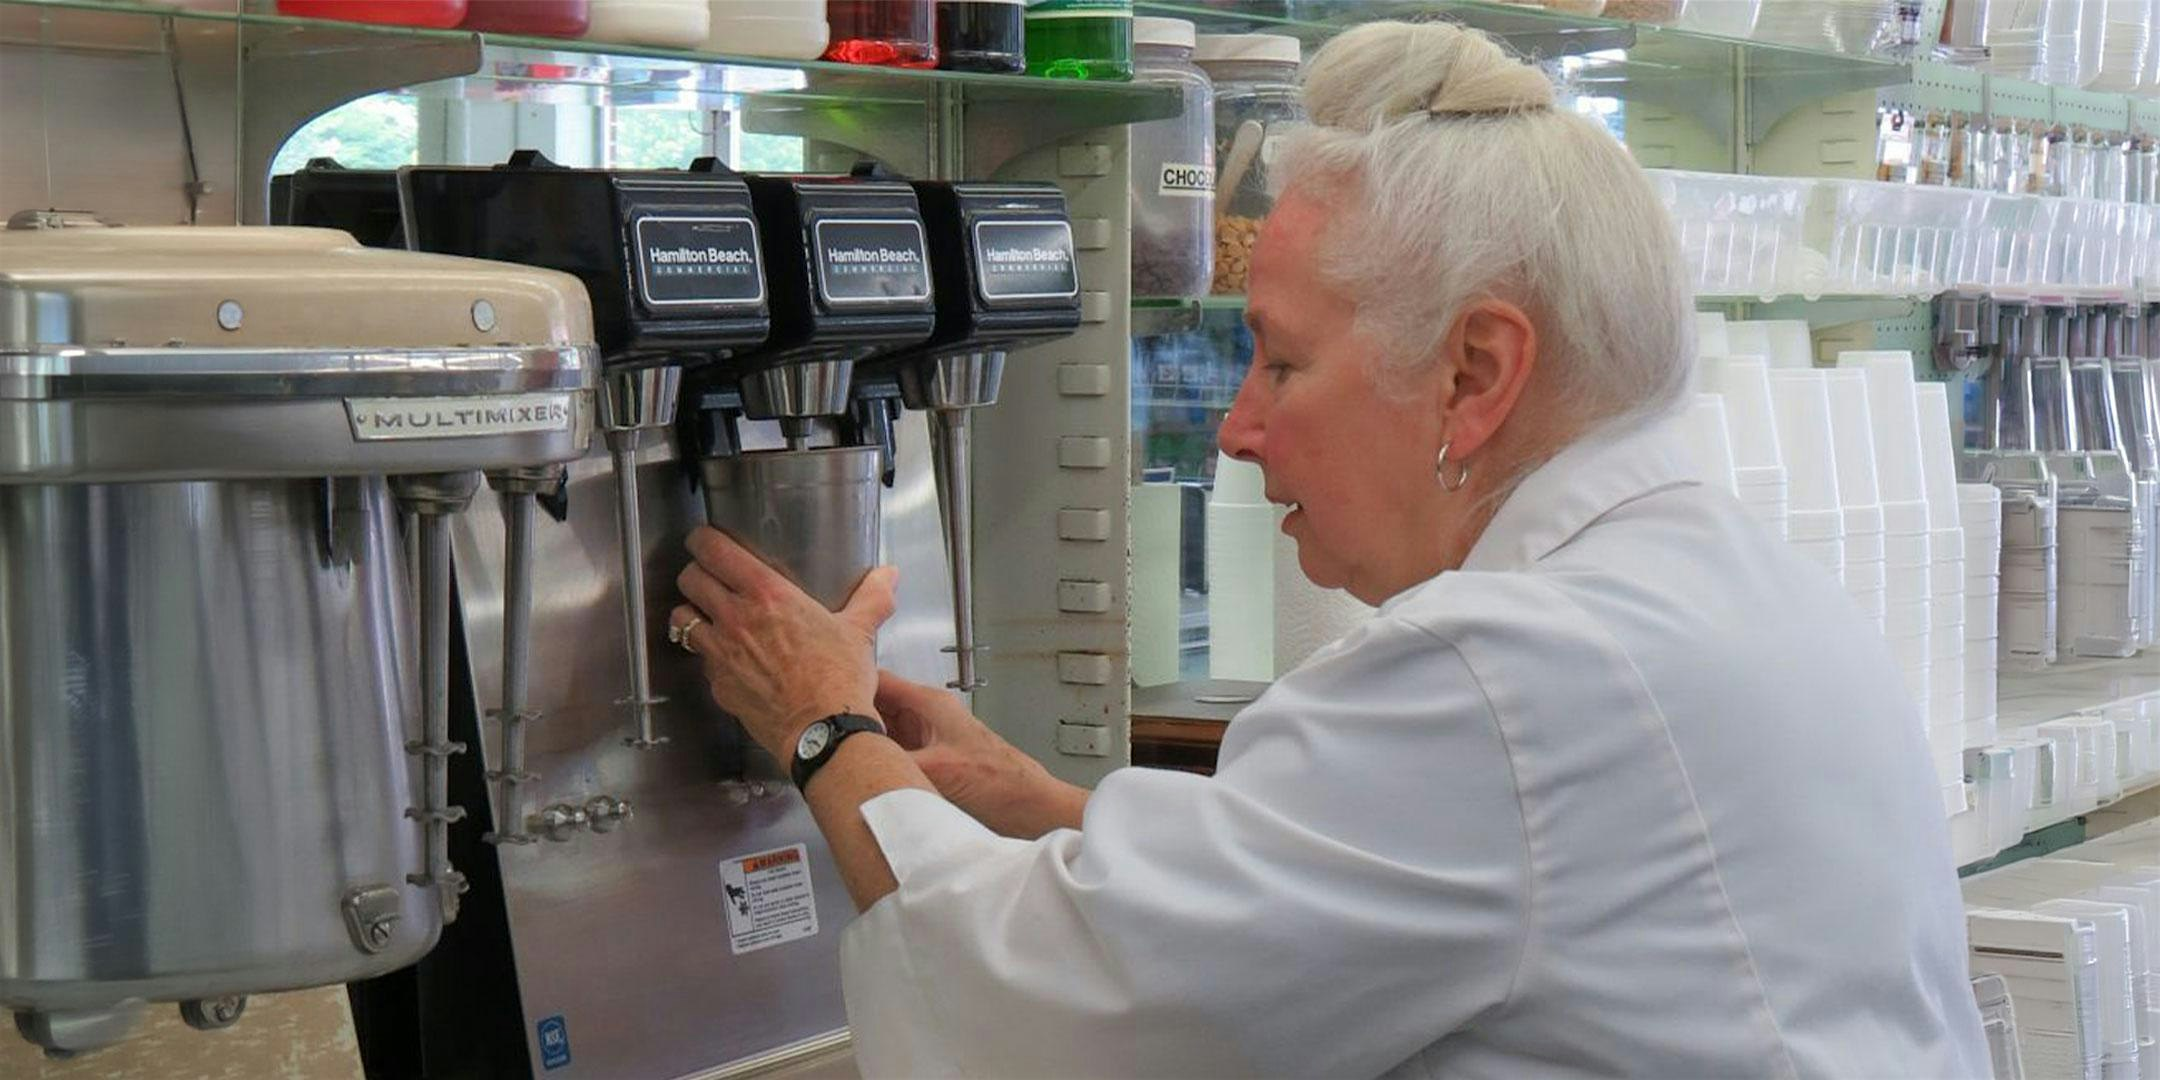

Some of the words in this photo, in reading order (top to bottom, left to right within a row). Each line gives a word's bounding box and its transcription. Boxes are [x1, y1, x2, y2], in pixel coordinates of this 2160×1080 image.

[649, 247, 707, 263] Hamilton
[828, 247, 879, 263] Hamilton
[374, 407, 563, 428] MULTIMIXER
